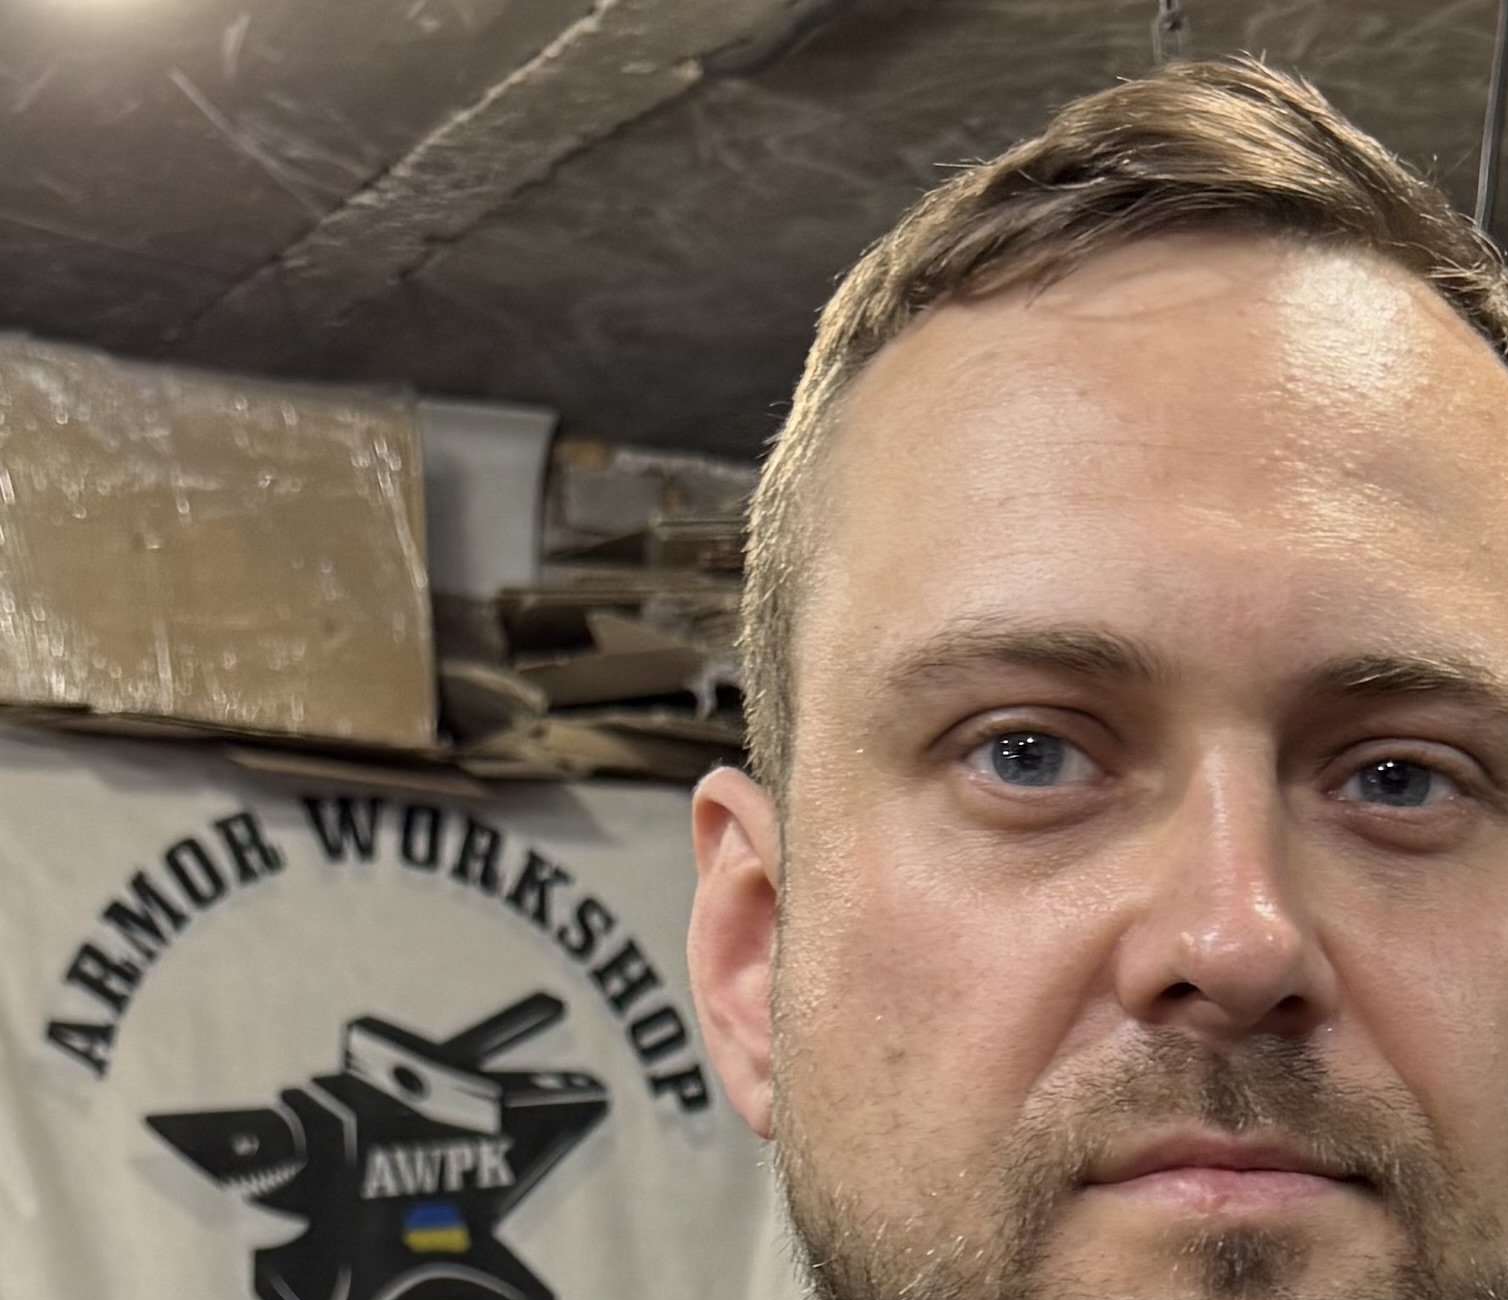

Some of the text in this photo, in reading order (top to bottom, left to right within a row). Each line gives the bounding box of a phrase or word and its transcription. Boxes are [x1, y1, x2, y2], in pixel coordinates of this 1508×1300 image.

[46, 795, 713, 1114] ARMOR WORKSHOP
[362, 1140, 515, 1198] AWPK
